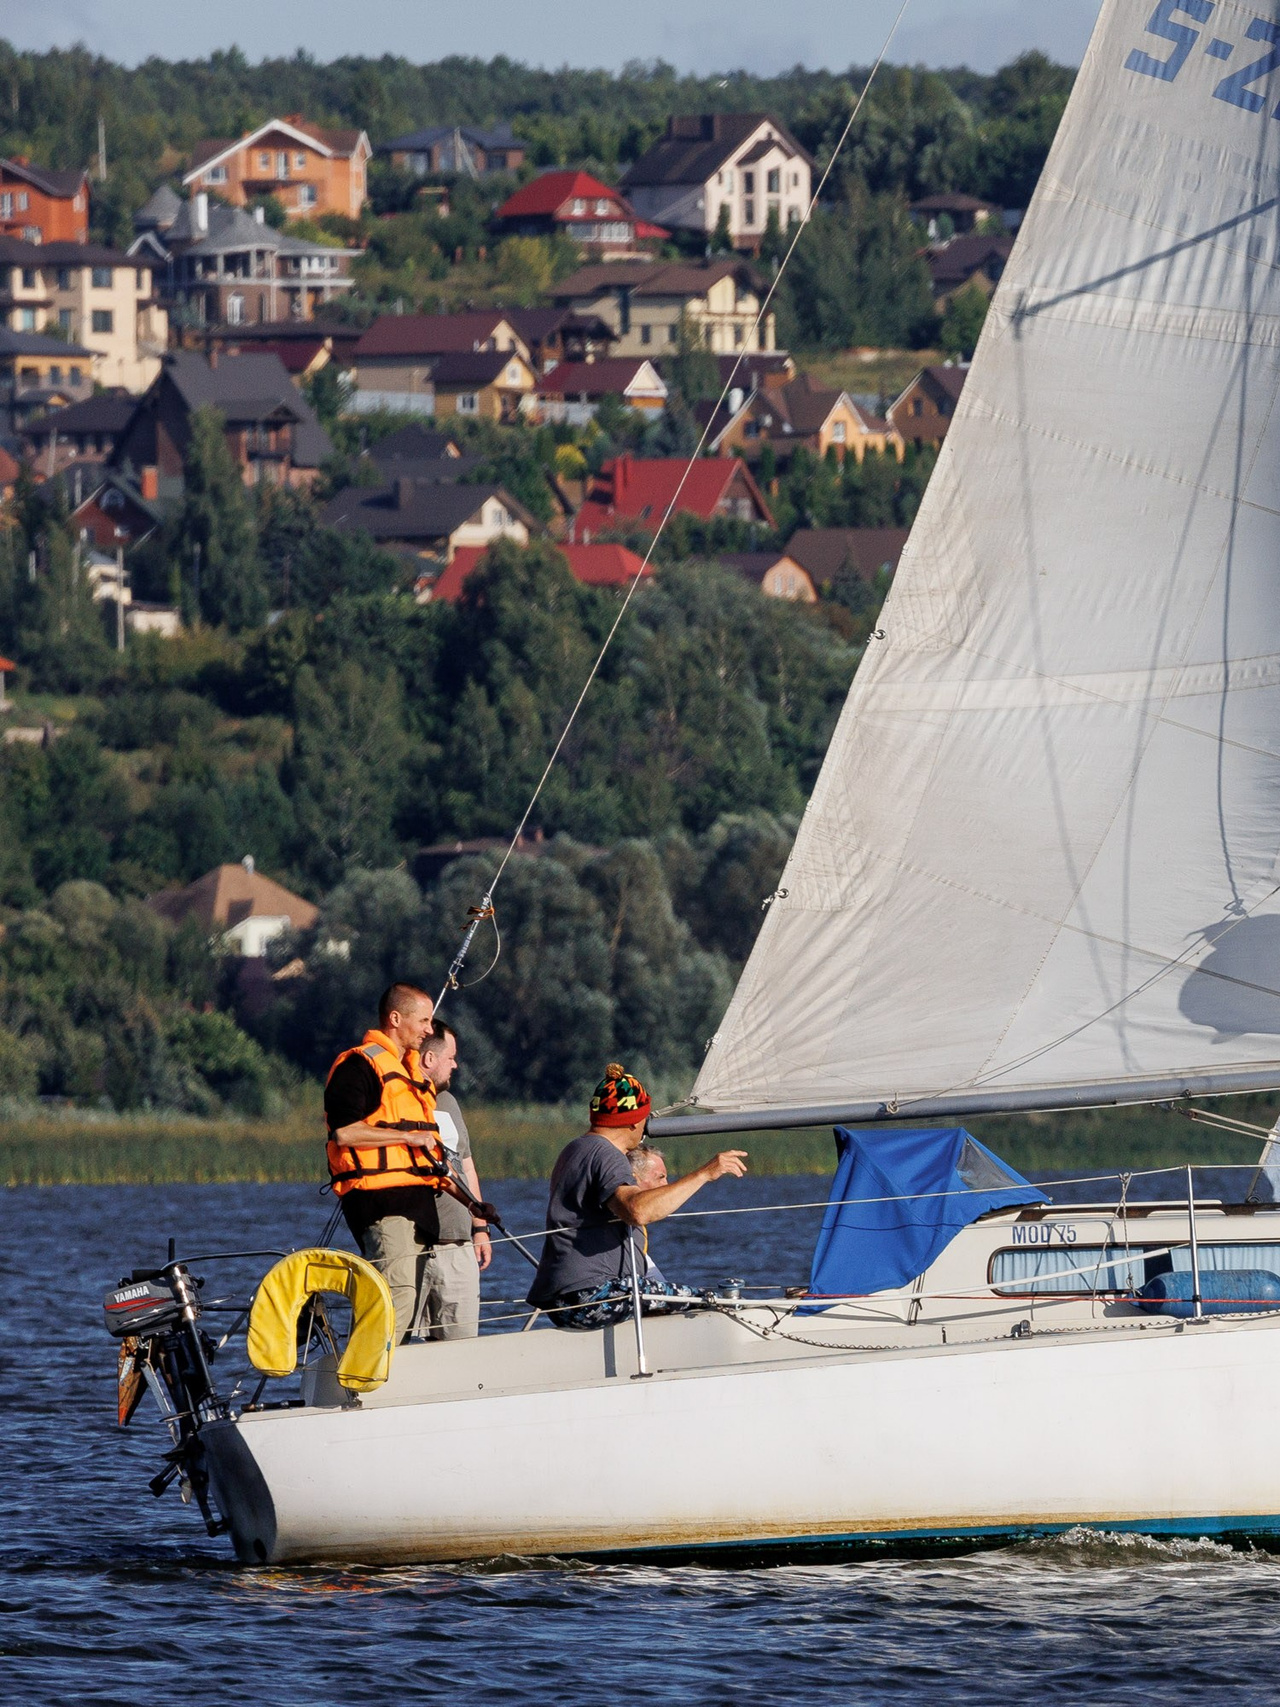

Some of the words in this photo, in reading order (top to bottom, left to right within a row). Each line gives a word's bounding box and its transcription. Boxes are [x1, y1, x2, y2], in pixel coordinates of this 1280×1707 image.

[1012, 1225, 1049, 1244] MOD
[1057, 1224, 1077, 1243] 75
[114, 1285, 150, 1303] YAMAHA
